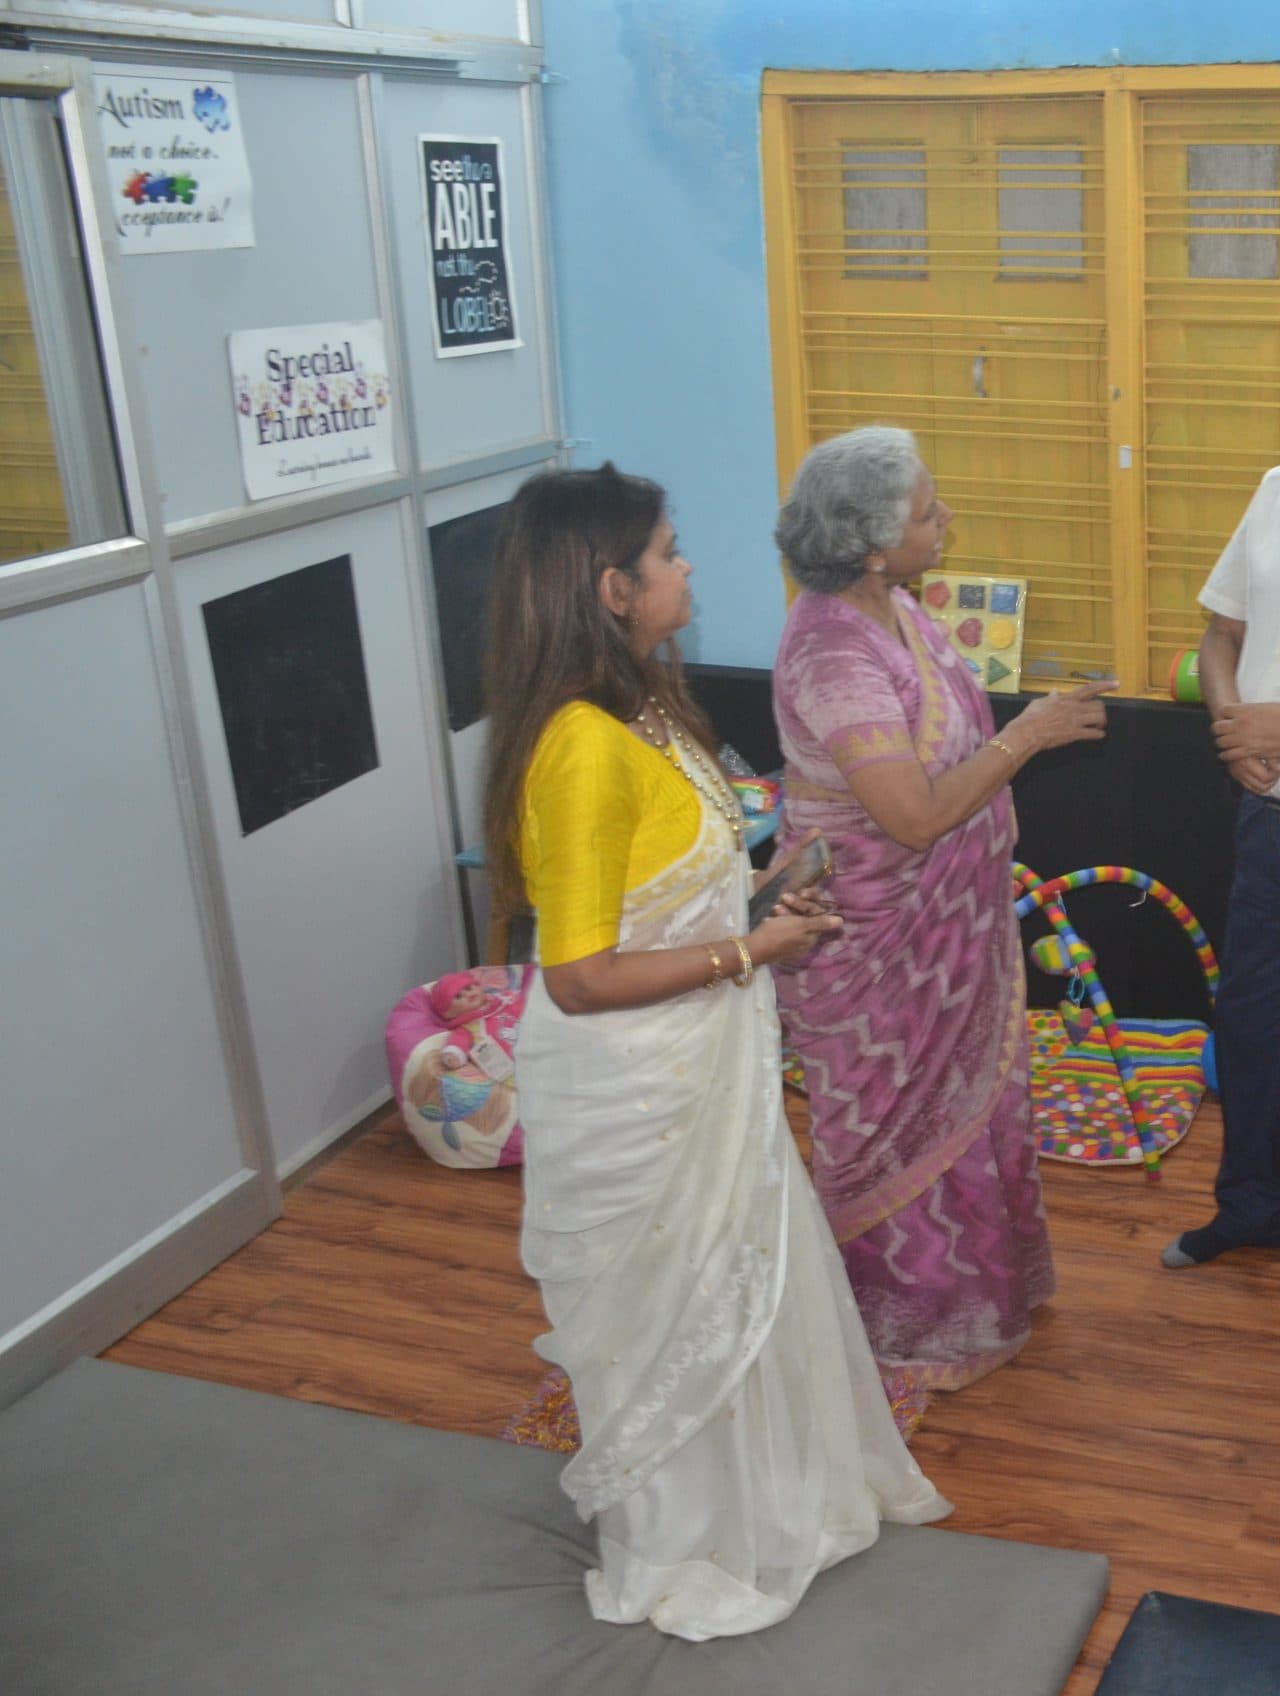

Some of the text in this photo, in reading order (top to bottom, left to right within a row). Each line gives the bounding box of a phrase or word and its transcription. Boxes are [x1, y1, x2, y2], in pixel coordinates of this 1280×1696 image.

[96, 86, 185, 129] Autism
[429, 159, 464, 182] see
[114, 206, 204, 238] cceptance
[434, 182, 499, 250] ABLE
[265, 340, 355, 390] Special
[255, 402, 377, 446] Education
